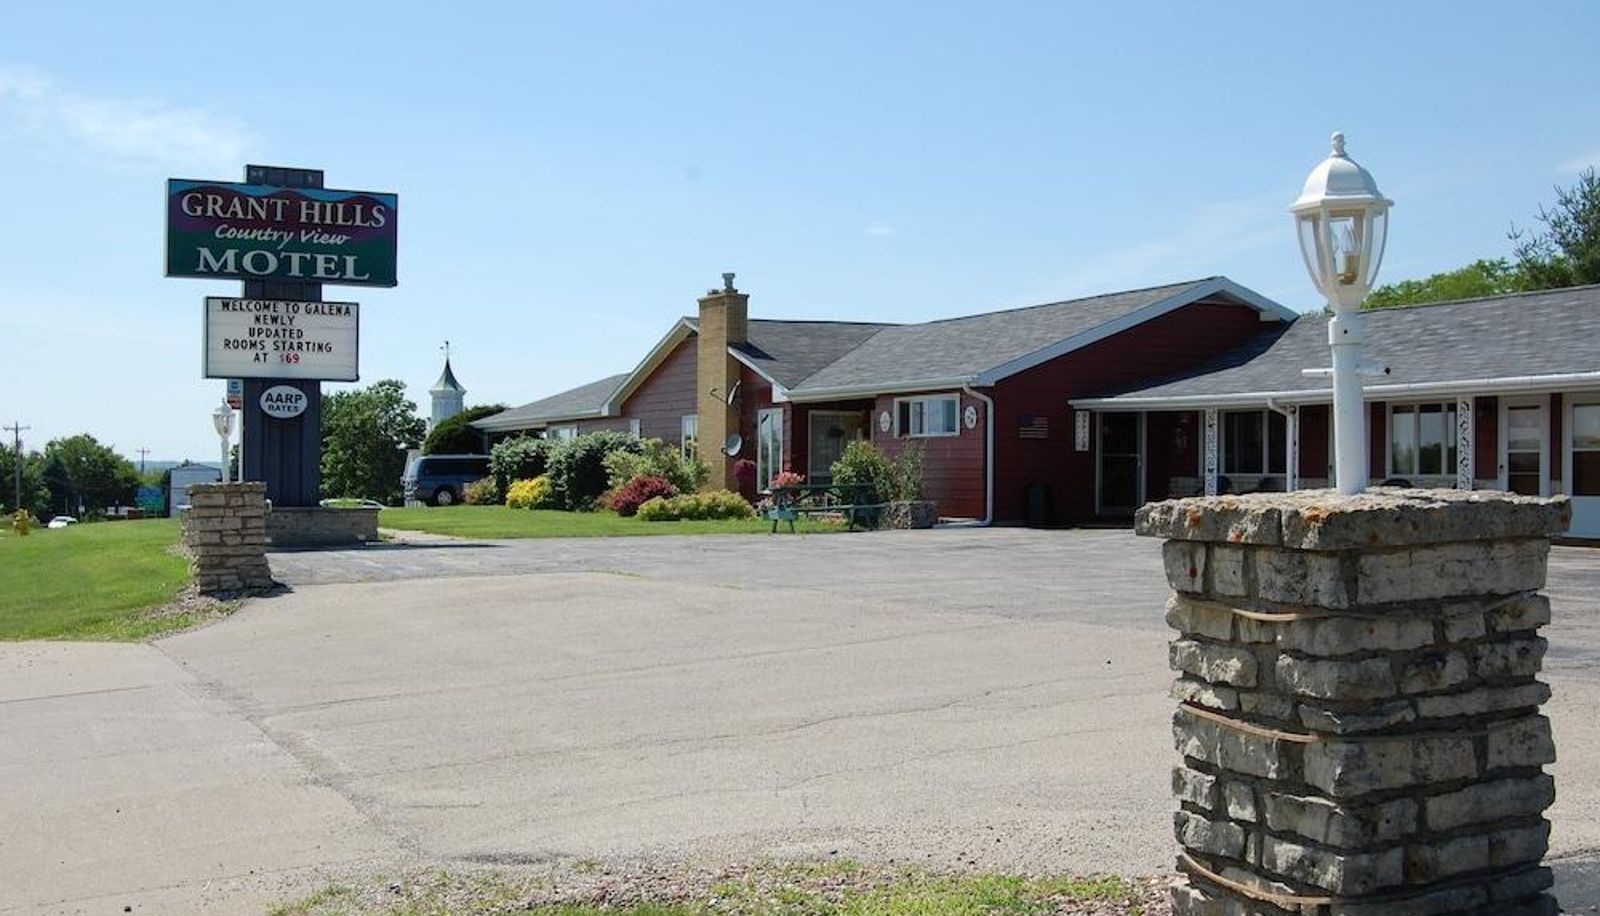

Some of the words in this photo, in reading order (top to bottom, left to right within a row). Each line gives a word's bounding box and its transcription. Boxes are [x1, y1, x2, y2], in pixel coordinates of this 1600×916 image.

[181, 192, 289, 222] GRANT
[299, 200, 386, 228] HILLS
[215, 223, 295, 249] Country
[300, 228, 351, 245] View
[195, 247, 370, 280] MOTEL
[221, 300, 280, 313] WELCOME
[285, 303, 300, 314] TO
[305, 303, 352, 317] GALENA
[254, 314, 296, 326] NEWLY
[248, 327, 304, 340] UPDATED
[223, 338, 266, 351] ROOMS
[273, 340, 333, 353] STARTING
[253, 352, 269, 363] AT
[265, 392, 303, 404] AARP
[268, 404, 299, 412] RATES
